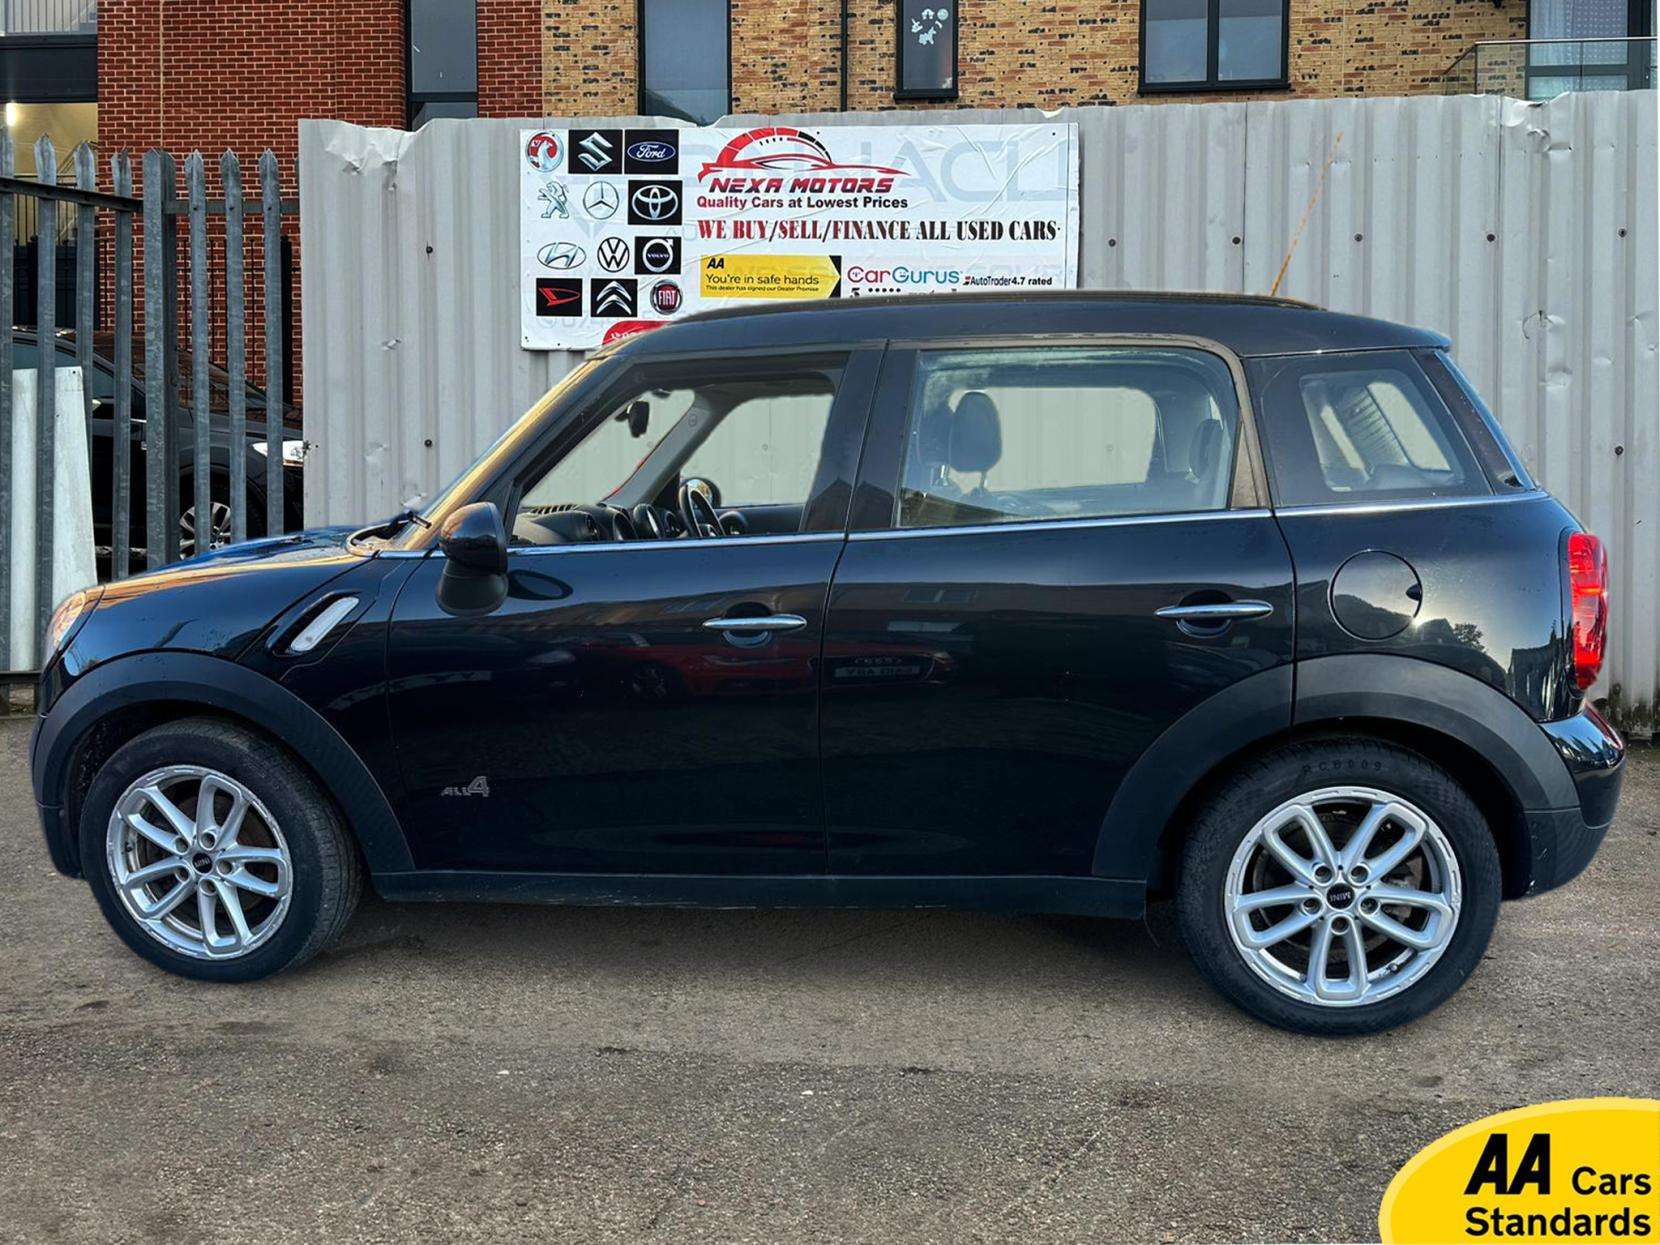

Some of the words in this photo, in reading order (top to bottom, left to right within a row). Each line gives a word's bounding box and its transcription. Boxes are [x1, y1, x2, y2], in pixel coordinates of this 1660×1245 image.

[636, 144, 666, 158] Ford
[708, 178, 783, 193] NEXA
[789, 178, 895, 193] MOTORS
[697, 195, 747, 210] Quality
[752, 196, 784, 208] Cars
[788, 196, 803, 208] at
[807, 196, 859, 208] Lowest
[863, 196, 908, 208] Prices
[697, 220, 727, 240] WE
[916, 220, 950, 240] ALL
[956, 220, 1004, 240] USED
[1008, 220, 1057, 240] CARS
[707, 257, 725, 270] AA
[705, 273, 741, 285] You're
[744, 274, 754, 284] in
[757, 274, 781, 285] safe
[784, 274, 820, 285] hands
[847, 266, 960, 284] CarGurus
[1011, 276, 1025, 286] 4.7
[1028, 276, 1053, 286] rated
[658, 289, 677, 306] FIAT
